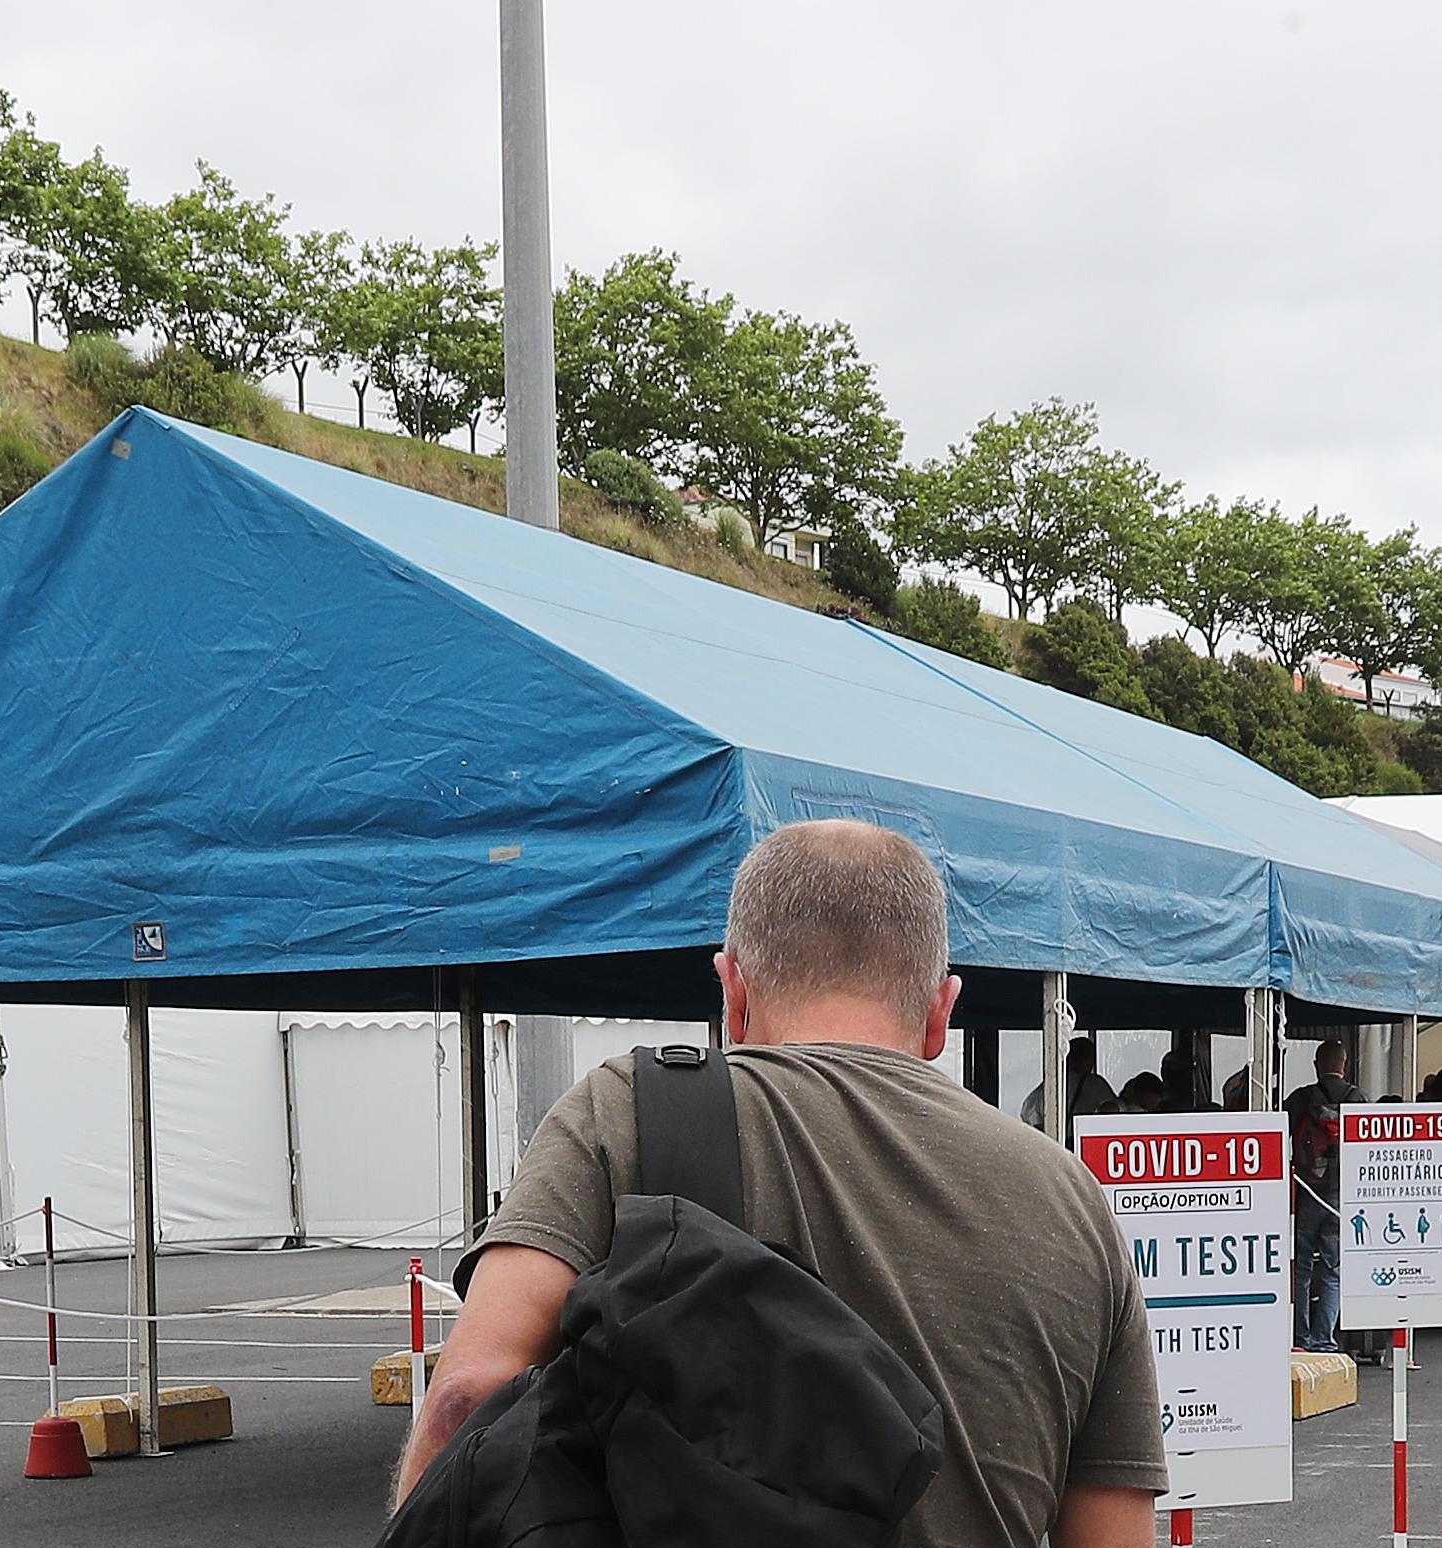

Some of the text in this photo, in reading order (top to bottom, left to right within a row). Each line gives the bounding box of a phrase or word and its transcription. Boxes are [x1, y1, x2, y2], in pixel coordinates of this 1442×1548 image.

[1107, 1137, 1261, 1179] COVID-19
[1368, 1149, 1433, 1162] PASSAGEIRO
[1121, 1189, 1245, 1211] OPÇÃO/OPTION 1
[1357, 1186, 1397, 1198] PRIORITY
[1175, 1234, 1281, 1277] TESTE
[1155, 1325, 1243, 1353] TH TEST
[1178, 1403, 1217, 1417] USISM
